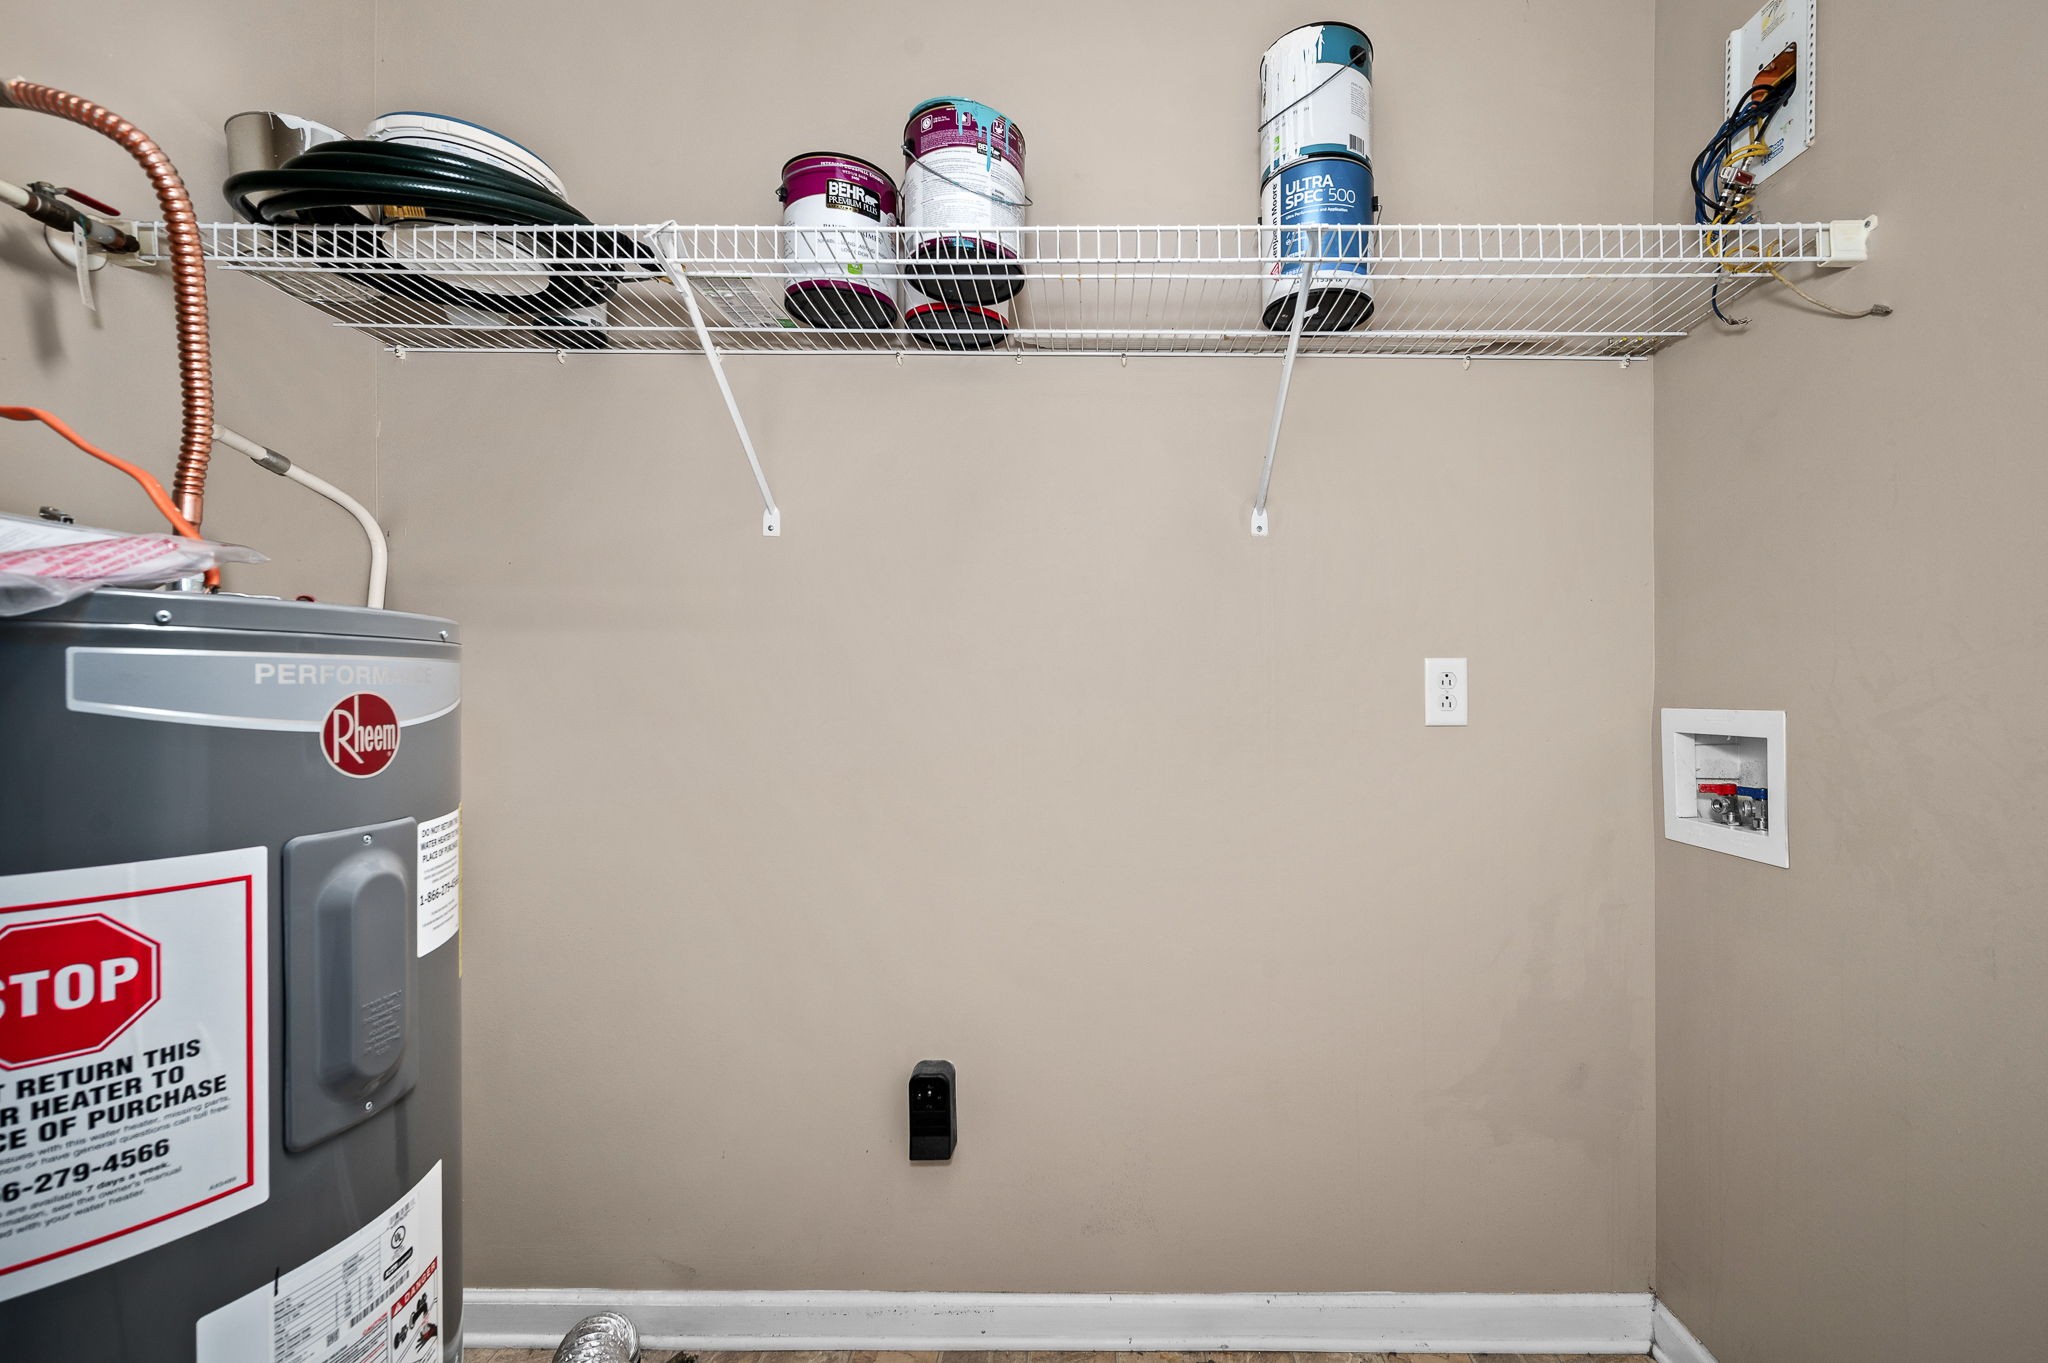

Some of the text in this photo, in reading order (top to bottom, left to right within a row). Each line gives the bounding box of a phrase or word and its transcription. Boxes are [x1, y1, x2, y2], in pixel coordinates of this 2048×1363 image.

[828, 180, 865, 203] BEHR
[828, 195, 862, 209] PREMIUM
[863, 202, 878, 215] PLUS
[1285, 174, 1334, 196] ULTRA
[1285, 188, 1356, 210] SPEC 500
[333, 694, 395, 764] Rheem
[0, 957, 139, 1019] TOP
[16, 1055, 133, 1101] RETURN
[143, 1039, 201, 1069] THIS
[30, 1077, 142, 1121] HEATER
[152, 1065, 185, 1089] TO
[38, 1115, 77, 1142] OF
[87, 1074, 227, 1131] PURCHASE
[37, 1143, 62, 1155] with
[65, 1137, 87, 1149] this
[89, 1128, 121, 1141] water
[163, 1102, 202, 1120] missing
[41, 1152, 70, 1165] have
[73, 1138, 116, 1157] general
[119, 1123, 171, 1143] questions
[0, 1138, 170, 1203] 6-279-4566
[30, 1188, 83, 1210] available
[86, 1185, 94, 1193] 7
[97, 1176, 125, 1189] days
[51, 1202, 74, 1213] see
[77, 1194, 96, 1206] the
[98, 1179, 142, 1199] owner's
[143, 1166, 182, 1184] manual
[44, 1211, 72, 1228] your
[74, 1202, 106, 1216] water
[404, 1259, 437, 1302] DANGER
